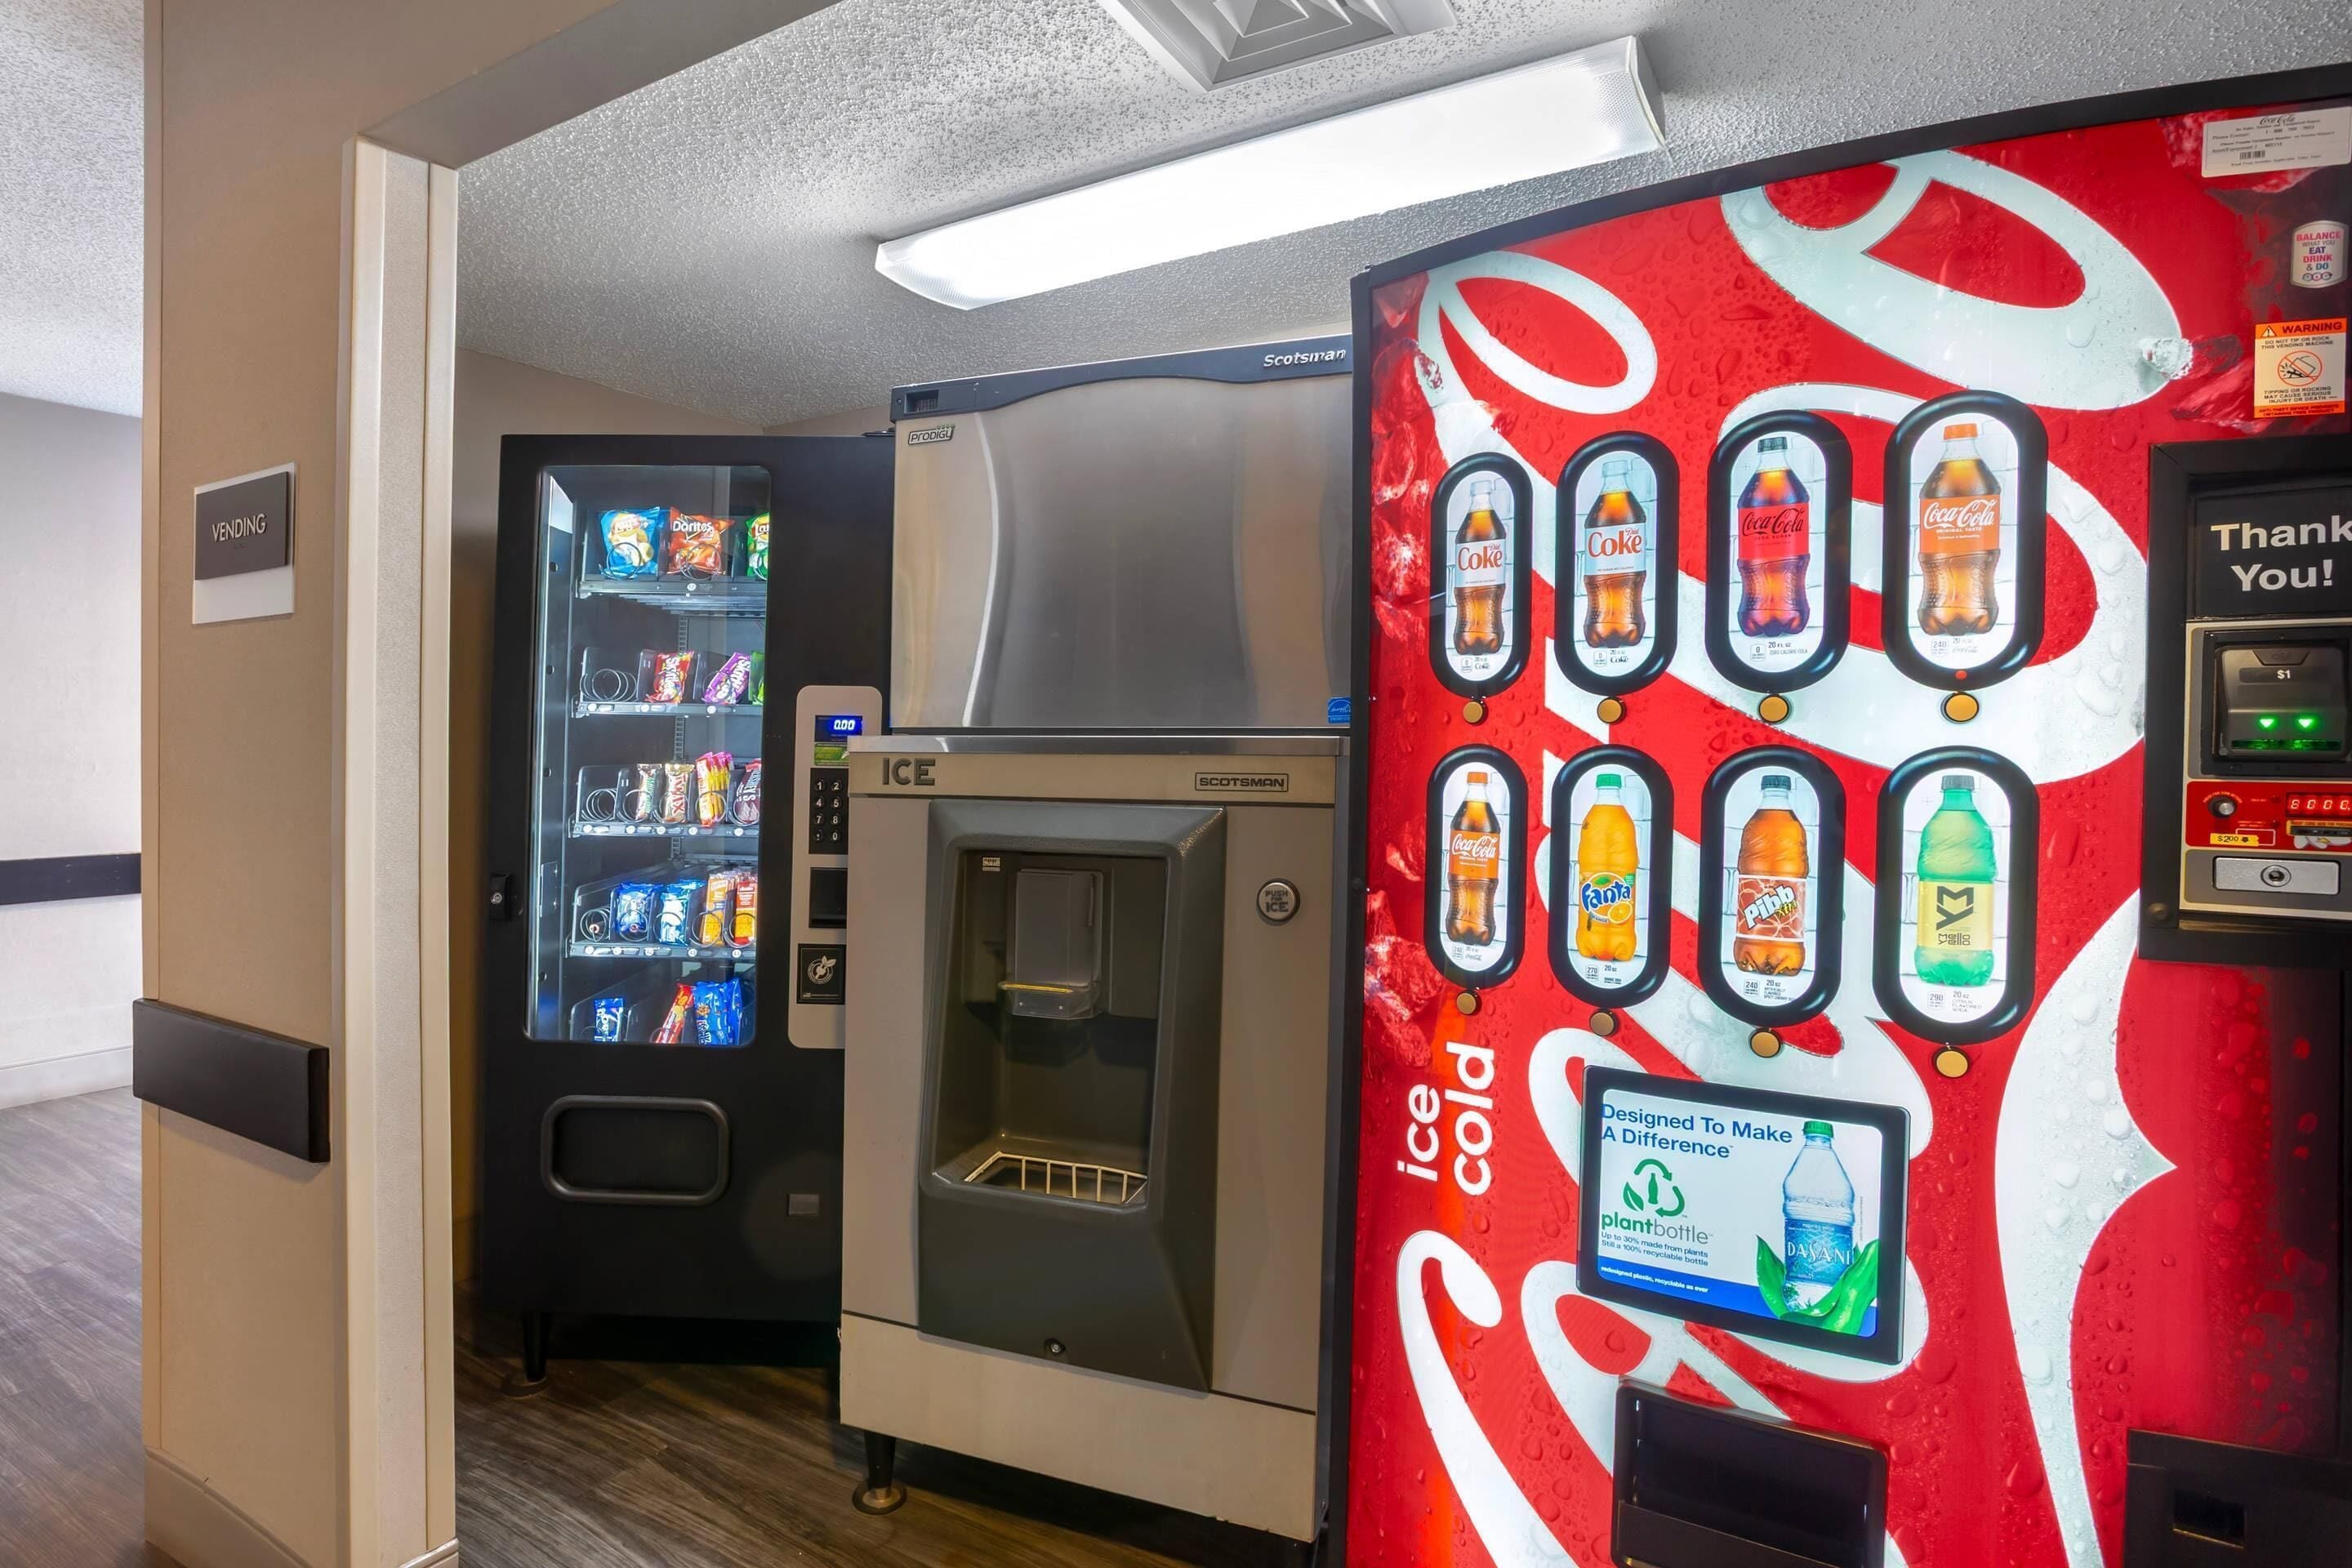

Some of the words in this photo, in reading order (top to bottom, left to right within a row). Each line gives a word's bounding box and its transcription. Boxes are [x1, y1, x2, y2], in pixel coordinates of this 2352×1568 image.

[2296, 231, 2341, 242] BALANCE
[2303, 254, 2333, 263] DRINK
[2309, 247, 2326, 255] EAT
[2316, 262, 2328, 270] DO
[2283, 322, 2342, 334] WARNING
[1263, 349, 1346, 367] Scotsman
[1742, 507, 1805, 537] Coca-Cola
[1924, 498, 1998, 529] Coca-Cola
[212, 513, 266, 542] VENDING
[672, 521, 713, 532] Doritos
[1588, 530, 1642, 558] Coke
[1458, 546, 1503, 571] Coke
[2230, 559, 2332, 591] You!
[1933, 640, 1947, 648] 240
[2277, 670, 2291, 679] $1
[883, 758, 935, 786] ICE
[1199, 777, 1285, 787] SCOTSMAN
[817, 799, 822, 807] 4
[833, 799, 840, 808] 5
[832, 832, 838, 840] 0
[1452, 833, 1498, 858] Coca-Cola
[1265, 902, 1289, 912] ICE
[1581, 880, 1631, 913] Fanta
[1744, 884, 1797, 930] Pibb
[1930, 993, 1944, 1001] 290
[1445, 1041, 1495, 1196] cold
[1602, 1104, 1694, 1130] Designed
[1700, 1116, 1725, 1134] To
[1732, 1120, 1793, 1143] Make
[1396, 1084, 1440, 1182] ice
[1602, 1126, 1616, 1142] A
[1623, 1128, 1730, 1158] Difference
[1601, 1211, 1709, 1245] plantbottle
[1601, 1239, 1615, 1247] Still
[1624, 1244, 1642, 1254] 100%
[1643, 1249, 1682, 1262] recyclable
[1685, 1256, 1708, 1266] bottle
[1624, 1236, 1640, 1245] 30%
[1641, 1240, 1663, 1249] made
[1664, 1243, 1682, 1252] from
[1684, 1248, 1708, 1258] plants
[1788, 1241, 1850, 1266] DASANI
[1601, 1266, 1633, 1277] redesigned
[1633, 1273, 1654, 1282] plastic,
[1655, 1277, 1685, 1289] recyclable
